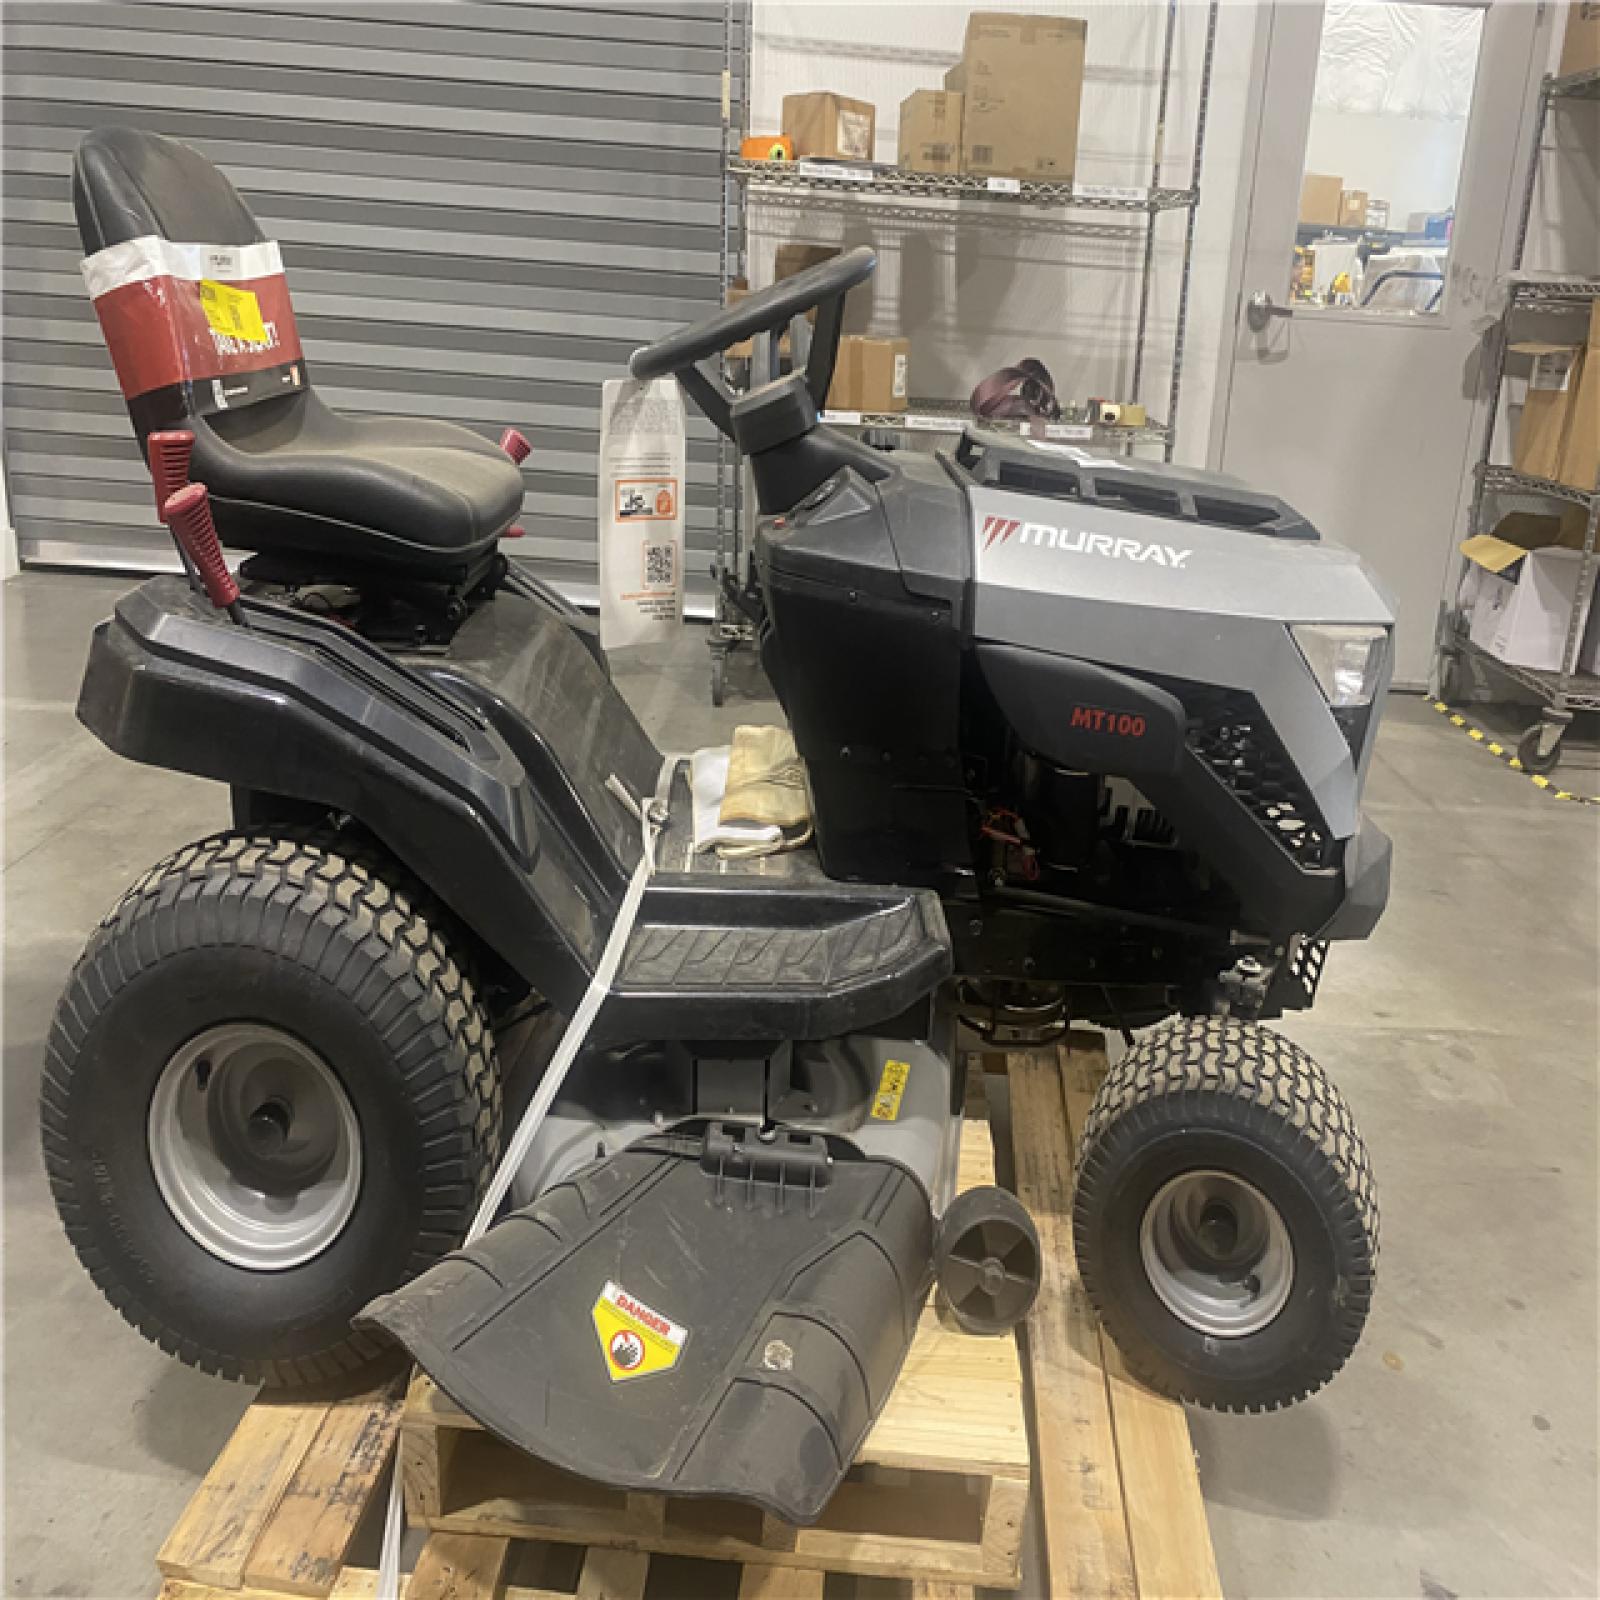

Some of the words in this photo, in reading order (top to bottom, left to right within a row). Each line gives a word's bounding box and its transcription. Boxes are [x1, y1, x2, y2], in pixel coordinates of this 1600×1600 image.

[1019, 522, 1192, 568] MURRAY
[1070, 706, 1146, 736] MT100
[615, 1294, 671, 1336] DANGER
